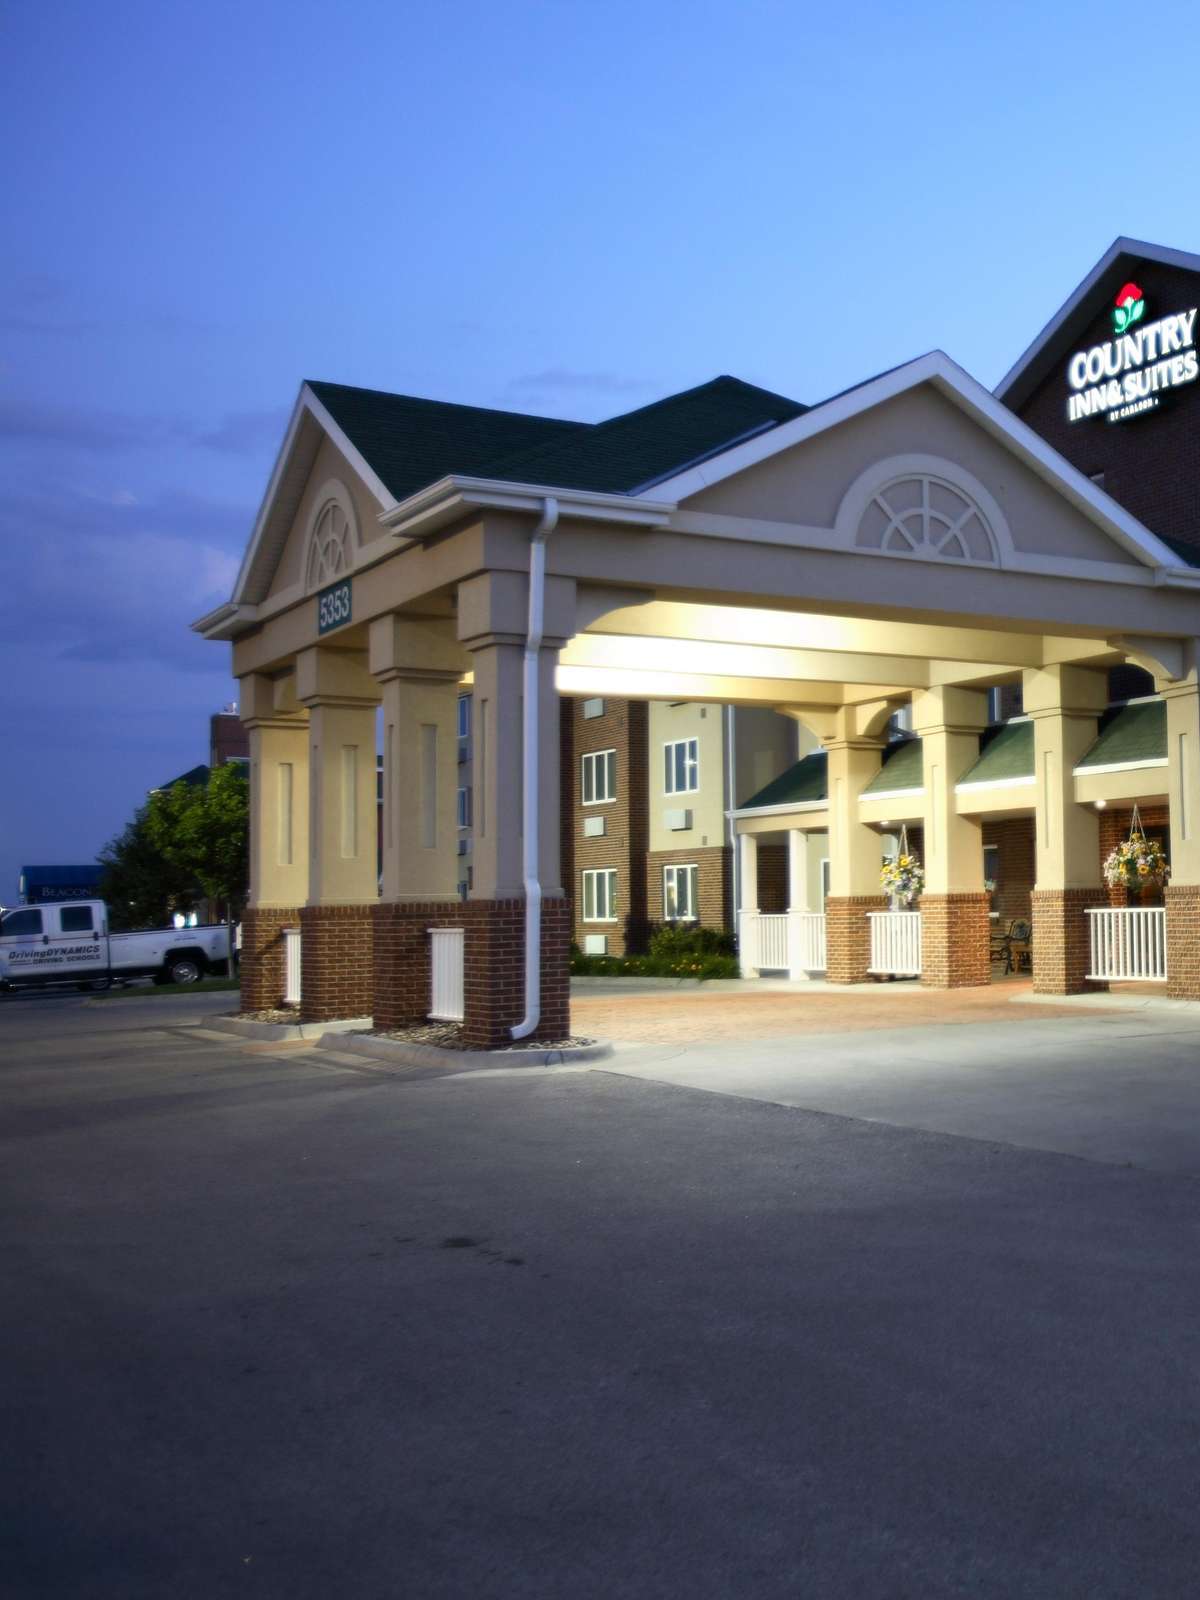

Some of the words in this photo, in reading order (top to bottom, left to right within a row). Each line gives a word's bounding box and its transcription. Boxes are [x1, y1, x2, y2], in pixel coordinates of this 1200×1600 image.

[1069, 307, 1197, 389] COUNTRY
[1110, 410, 1120, 421] BY
[320, 586, 349, 627] 5353
